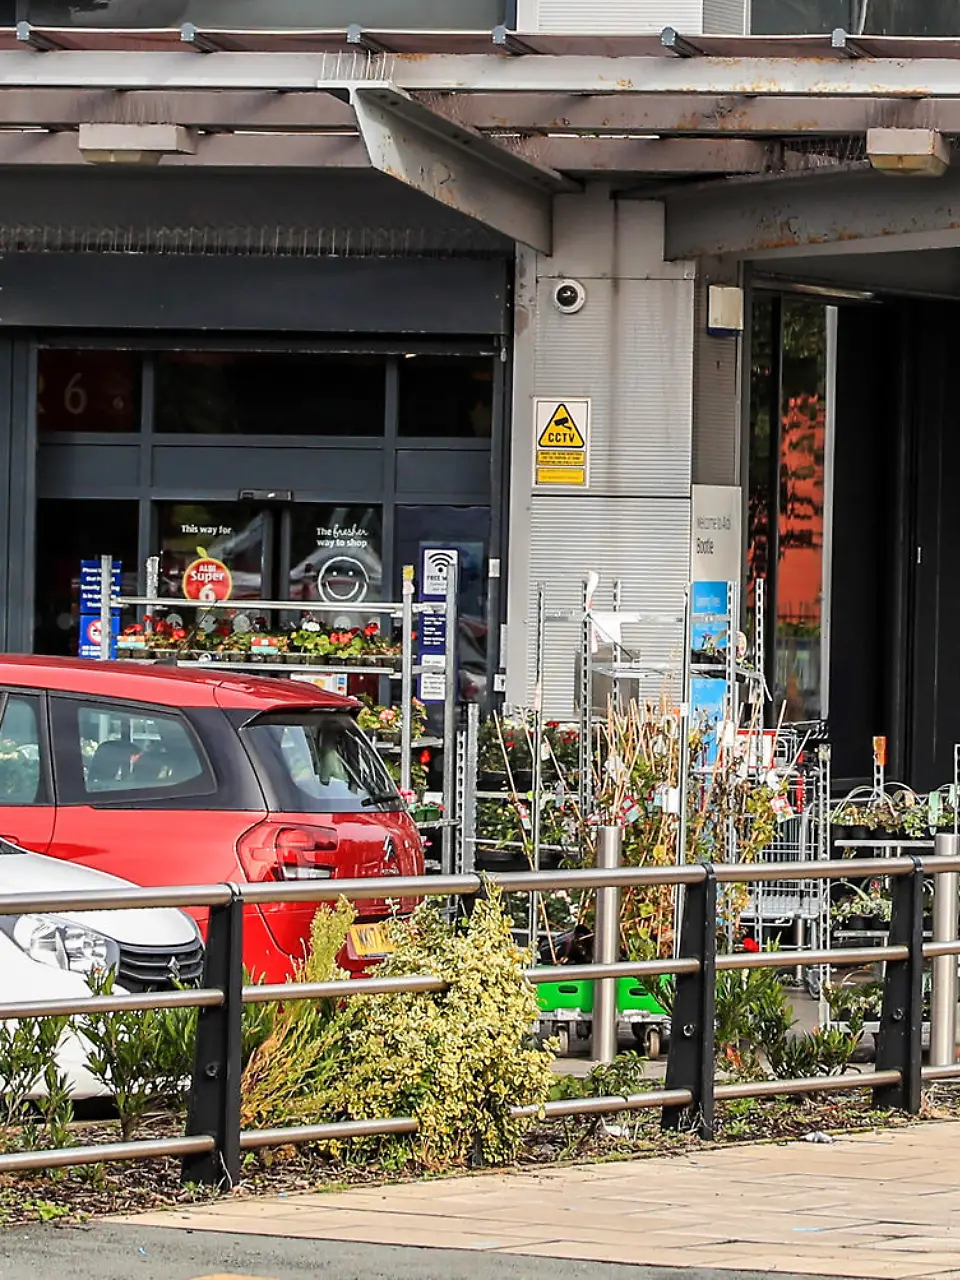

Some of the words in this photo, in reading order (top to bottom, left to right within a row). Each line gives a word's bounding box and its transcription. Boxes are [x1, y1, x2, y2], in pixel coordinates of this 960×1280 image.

[548, 432, 575, 443] CCTV
[182, 524, 199, 534] This
[200, 525, 218, 536] way
[219, 525, 232, 535] for
[316, 527, 332, 536] The
[333, 523, 369, 539] fresher
[316, 539, 335, 549] way
[336, 539, 346, 547] to
[346, 538, 368, 549] shop
[696, 537, 714, 555] Bootle
[190, 570, 225, 583] Super
[199, 583, 216, 602] 6
